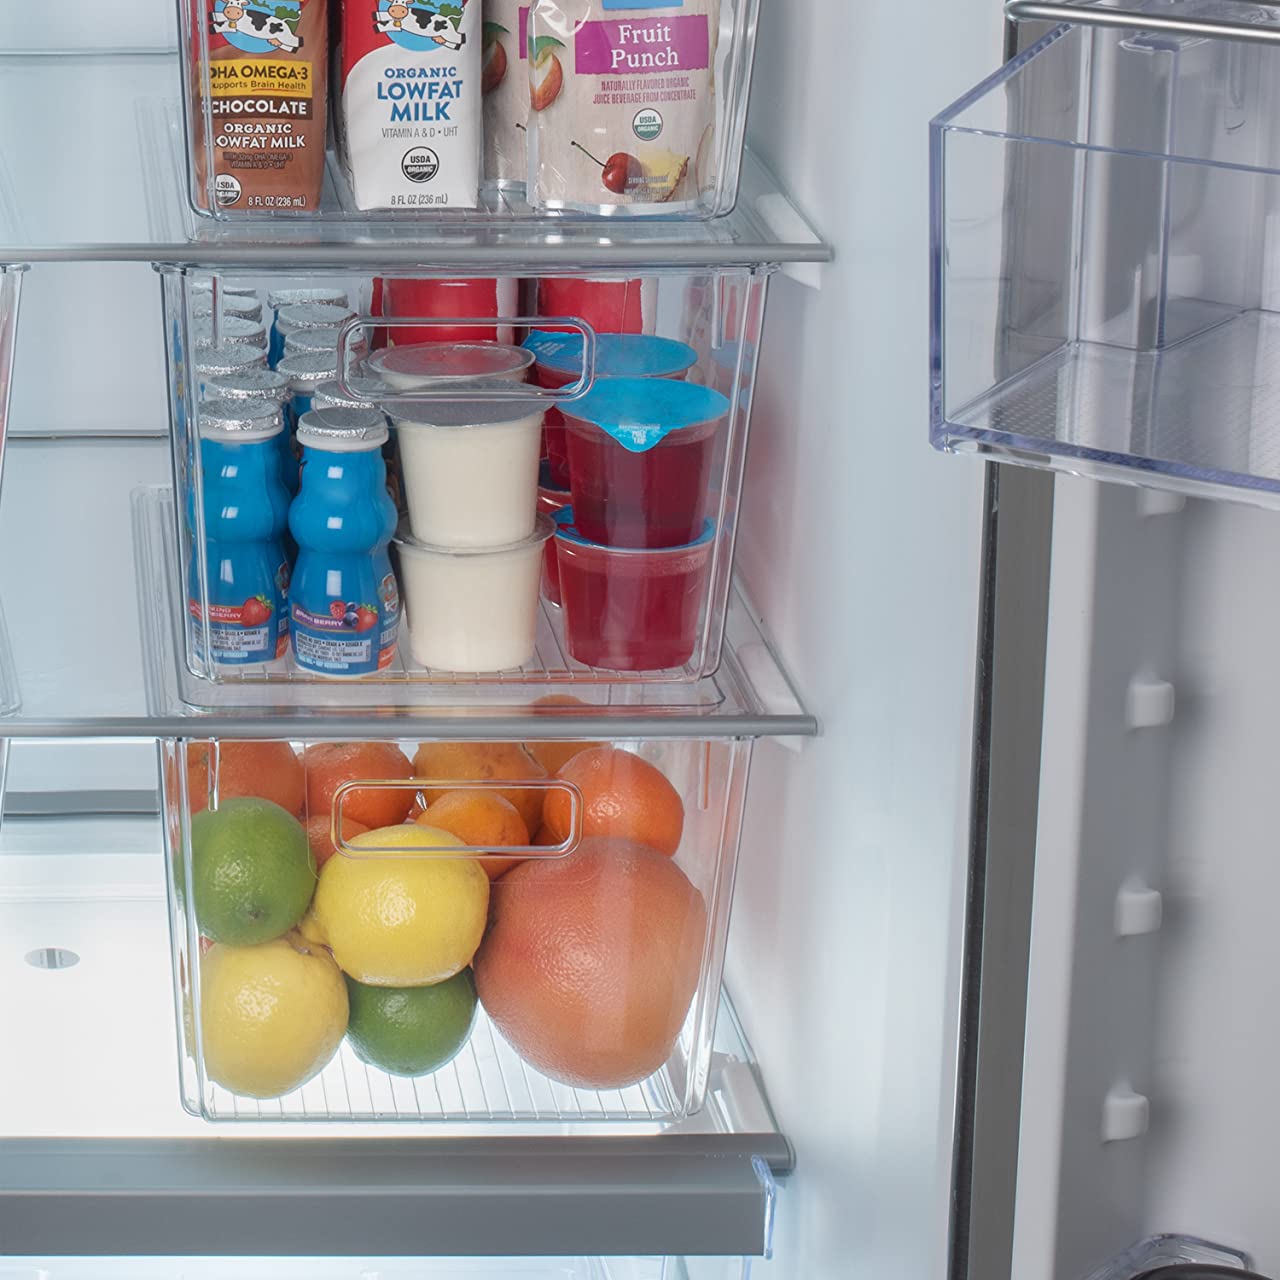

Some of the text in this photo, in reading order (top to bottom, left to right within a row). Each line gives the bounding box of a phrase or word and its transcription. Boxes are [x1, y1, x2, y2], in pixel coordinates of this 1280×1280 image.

[618, 23, 672, 44] Fruit
[611, 47, 679, 68] Punch
[241, 65, 308, 80] OMEGA-3
[384, 66, 457, 78] ORGANIC
[212, 81, 248, 89] upports
[278, 81, 306, 90] Health
[377, 80, 463, 100] LOWFAT
[601, 77, 689, 91] NATURALLY FLAVORED ORGANIC
[593, 89, 696, 104] JUICE BEVERAGE FROM CONCENTRATE
[211, 100, 307, 115] CHOCOLATE
[390, 101, 451, 122] MILK
[224, 123, 292, 134] ORGANIC
[382, 126, 458, 138] VITAMIN A & D UHT
[216, 135, 305, 148] OWFAT MILK
[248, 195, 306, 207] 8 FL OZ (236 mL)
[391, 193, 448, 205] 8 FL OZ (236 mL)
[314, 618, 342, 627] BERRY
